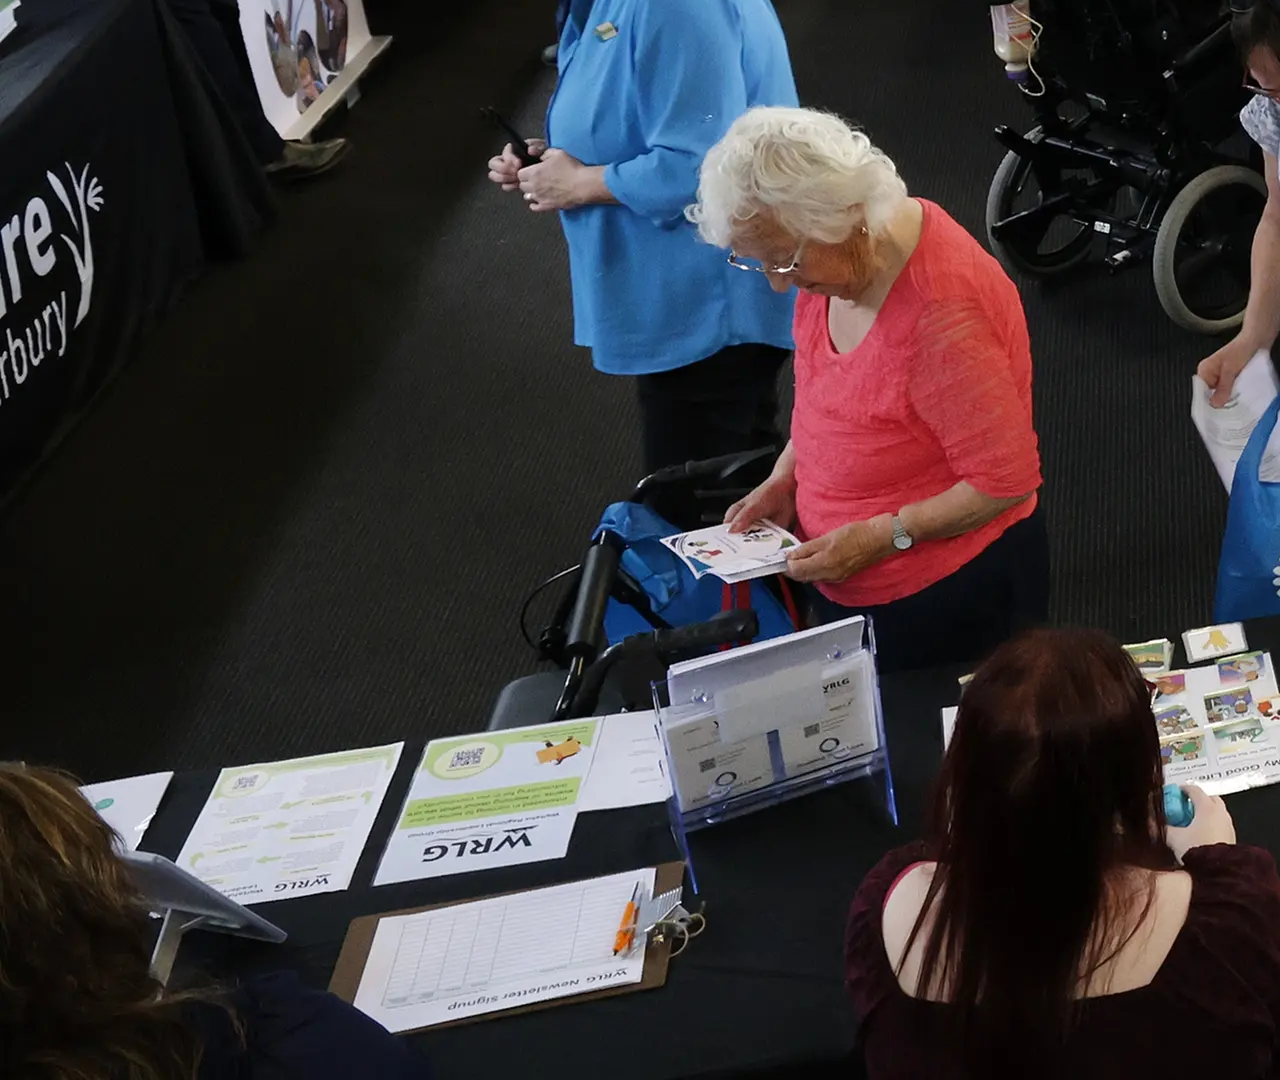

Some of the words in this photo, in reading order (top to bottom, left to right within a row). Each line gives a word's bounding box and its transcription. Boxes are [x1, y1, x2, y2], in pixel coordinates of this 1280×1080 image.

[0, 197, 57, 317] re
[0, 291, 67, 406] rbury
[1225, 763, 1261, 777] Good
[422, 832, 533, 863] WRLG
[274, 876, 330, 893] WRLG
[585, 969, 628, 983] WRLG
[501, 978, 579, 1000] Newsletter
[448, 994, 499, 1012] Signup
